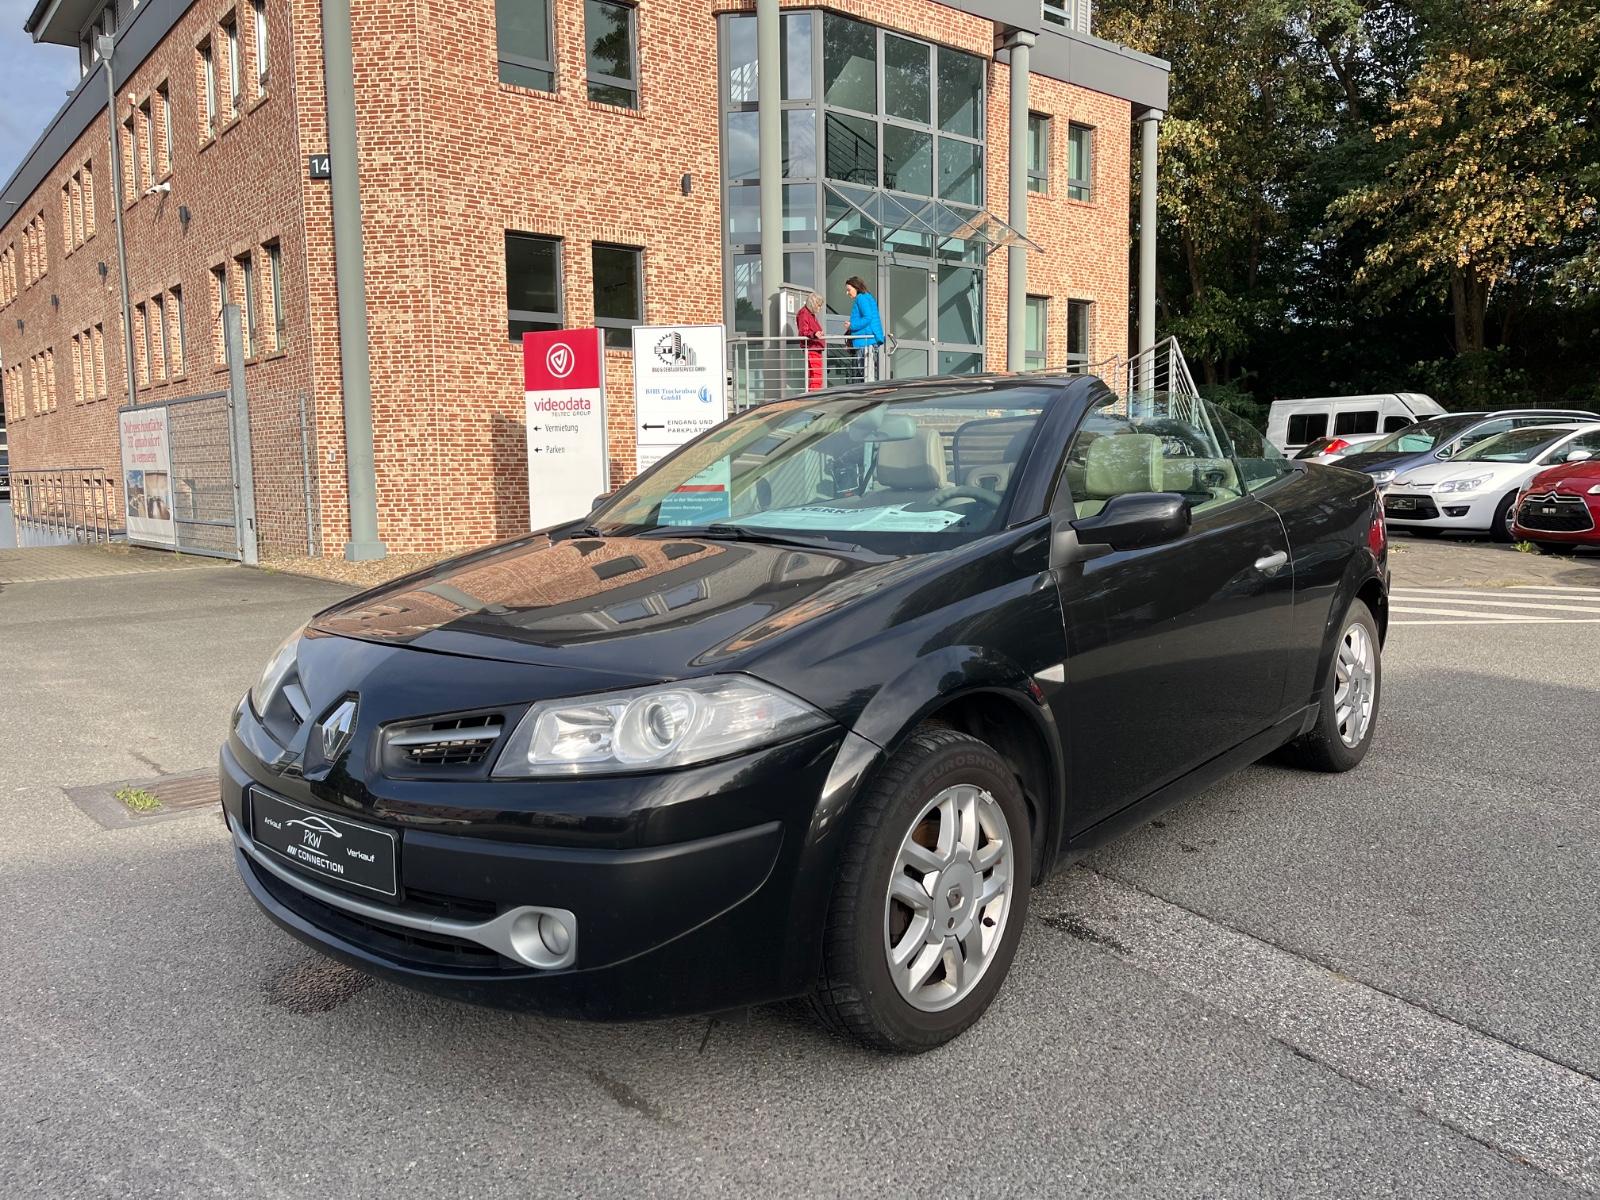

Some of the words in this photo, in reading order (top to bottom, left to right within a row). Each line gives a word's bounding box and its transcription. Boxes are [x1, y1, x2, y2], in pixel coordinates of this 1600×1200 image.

[311, 158, 330, 174] 14
[534, 396, 591, 412] videodata
[544, 424, 579, 434] Vermietung
[546, 445, 565, 454] Parken
[303, 829, 322, 849] PKW
[298, 851, 344, 874] CONNECTION
[346, 848, 375, 863] Verkauf
